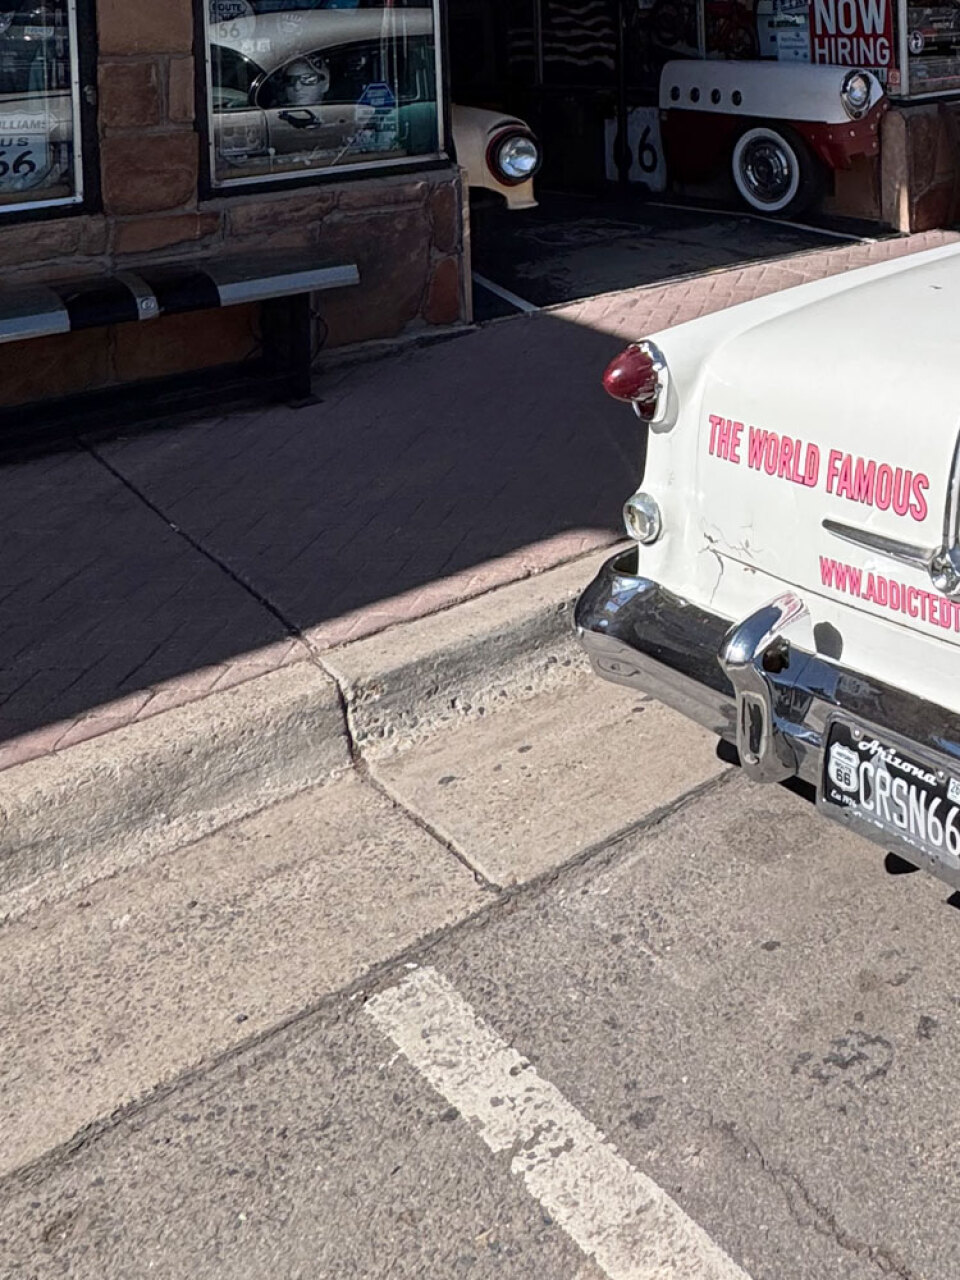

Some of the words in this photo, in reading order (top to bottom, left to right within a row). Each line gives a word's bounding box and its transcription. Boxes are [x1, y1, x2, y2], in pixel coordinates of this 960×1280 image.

[813, 37, 891, 65] HIRING
[0, 136, 29, 148] US
[708, 414, 744, 464] THE
[748, 425, 820, 489] WORLD
[826, 449, 930, 523] FAMOUS
[858, 739, 938, 787] Arizona
